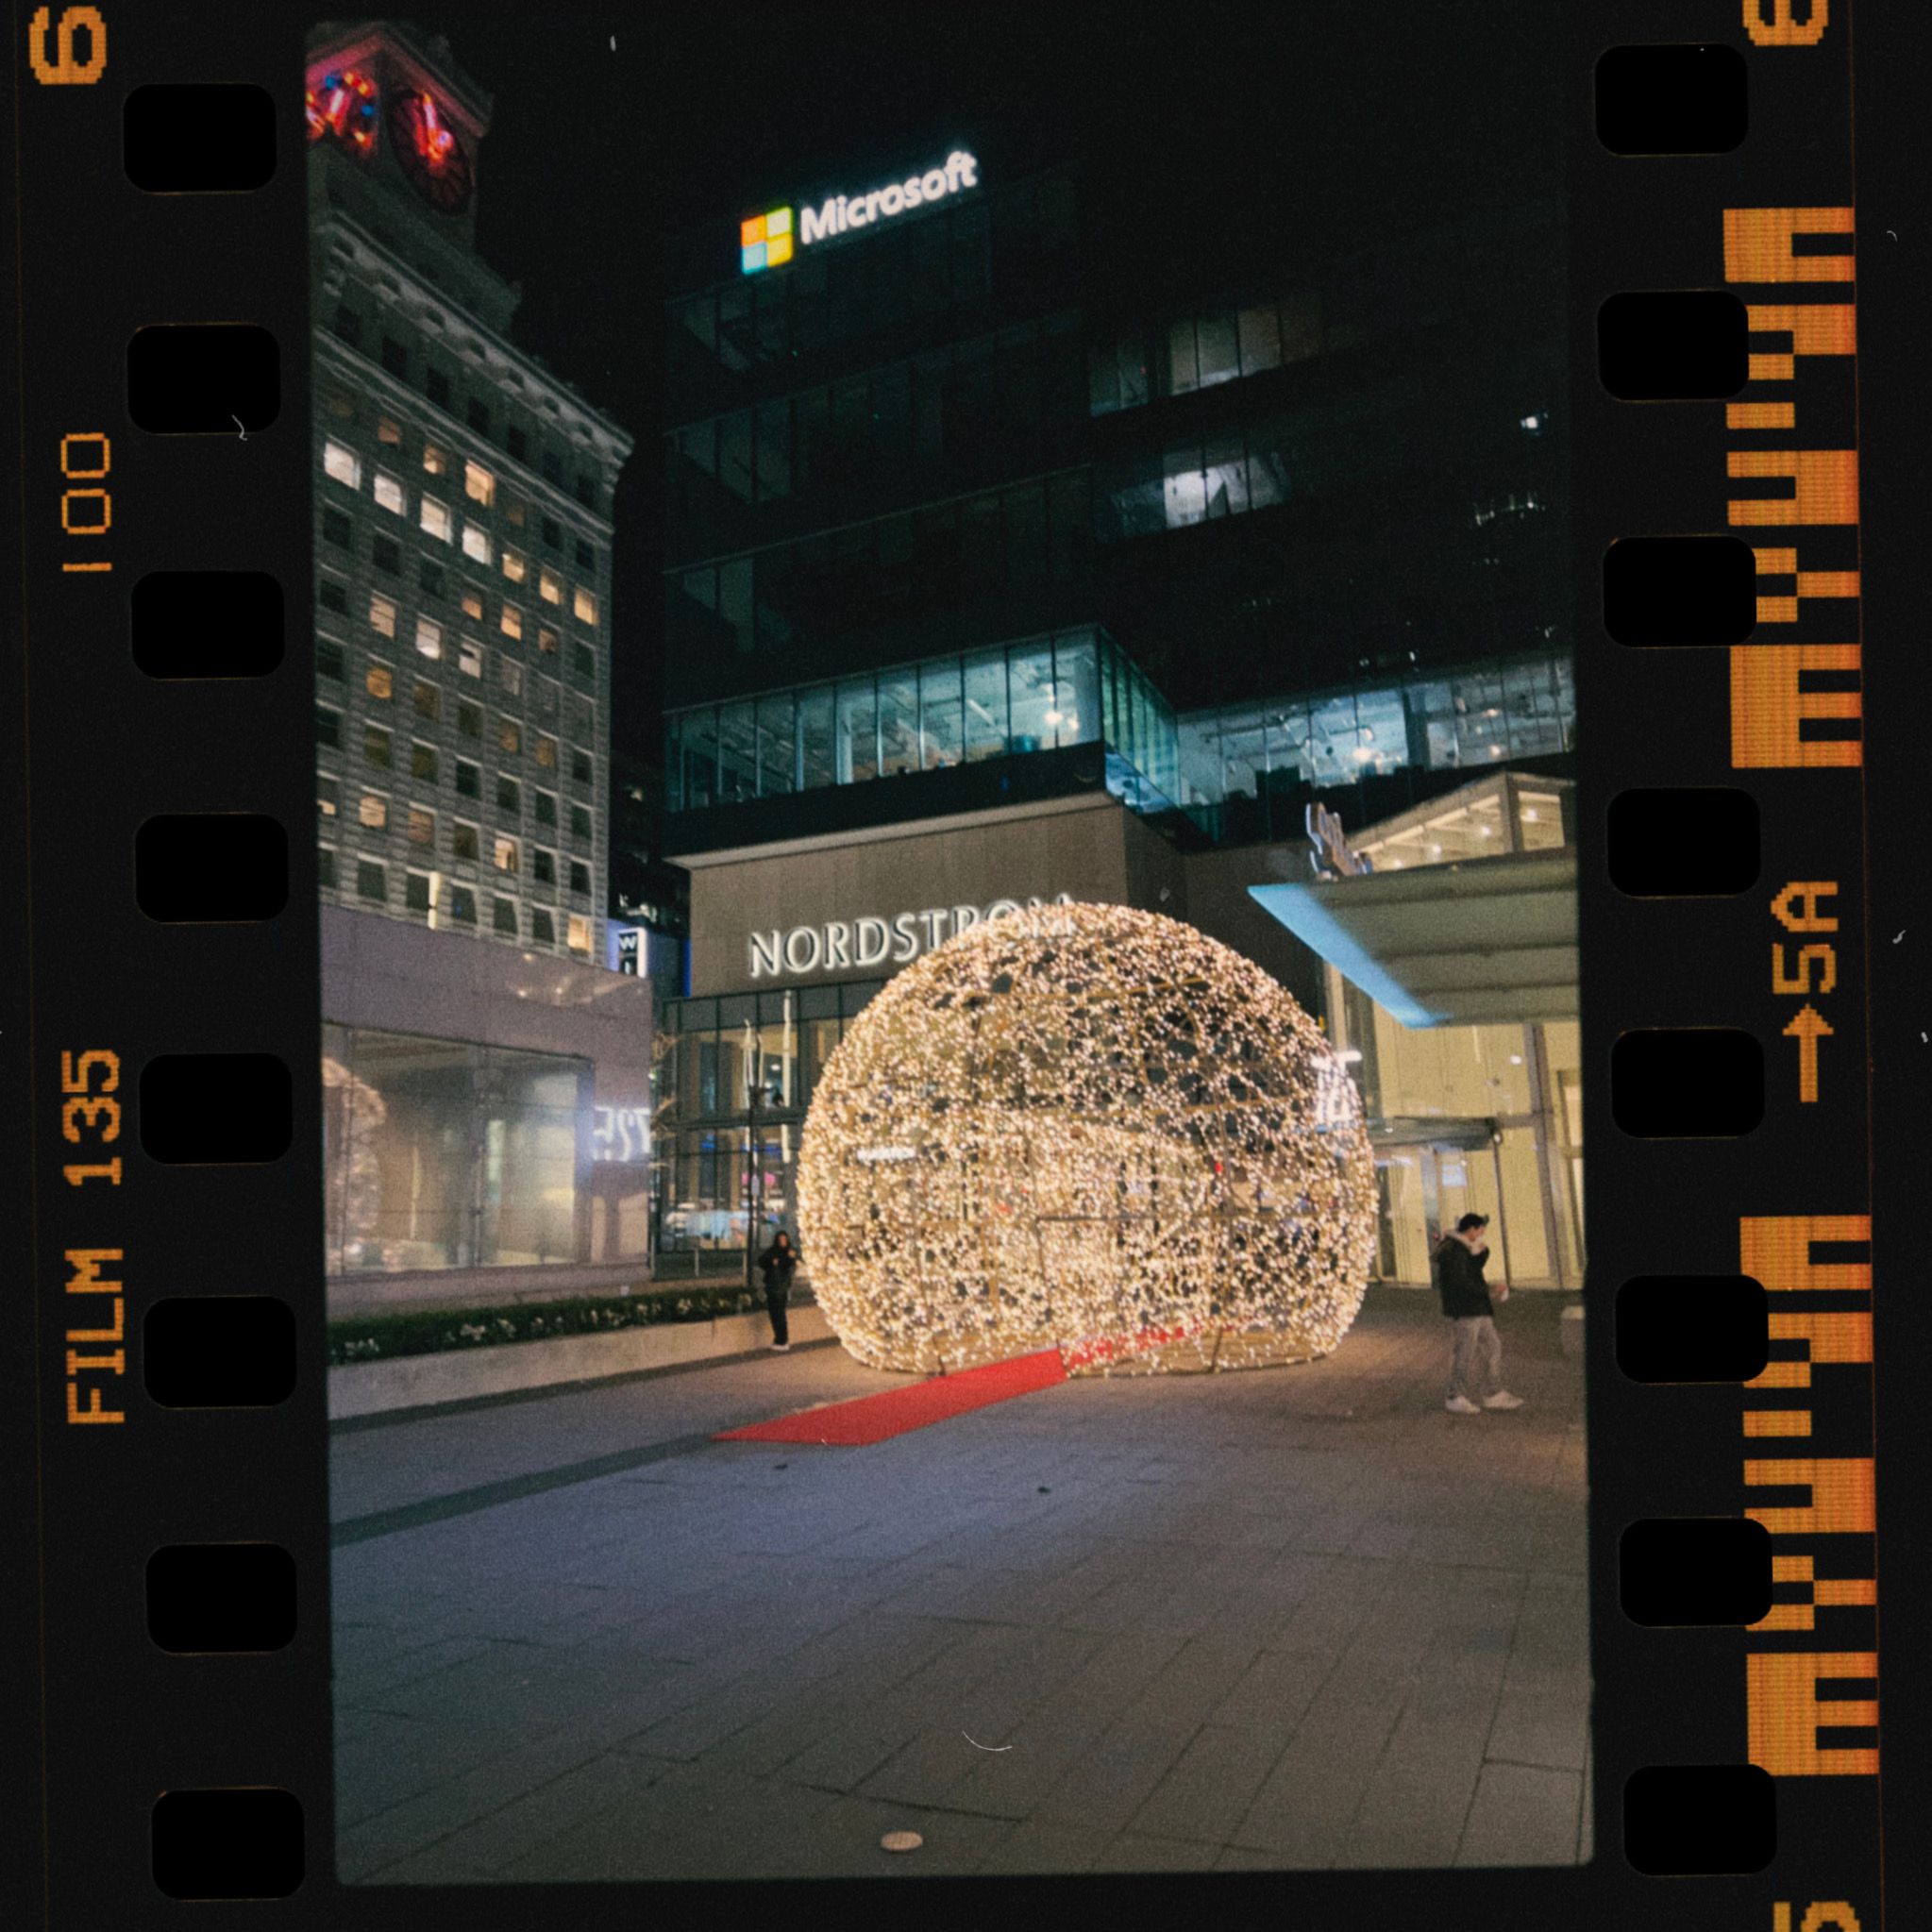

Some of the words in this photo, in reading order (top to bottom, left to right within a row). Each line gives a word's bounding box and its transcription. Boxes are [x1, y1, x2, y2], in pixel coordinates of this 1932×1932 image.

[28, 6, 107, 85] 6
[800, 150, 978, 245] Microsoft
[60, 432, 112, 572] 100
[1771, 882, 1839, 994] 5A
[61, 1050, 122, 1185] 135
[65, 1249, 125, 1423] FILM
